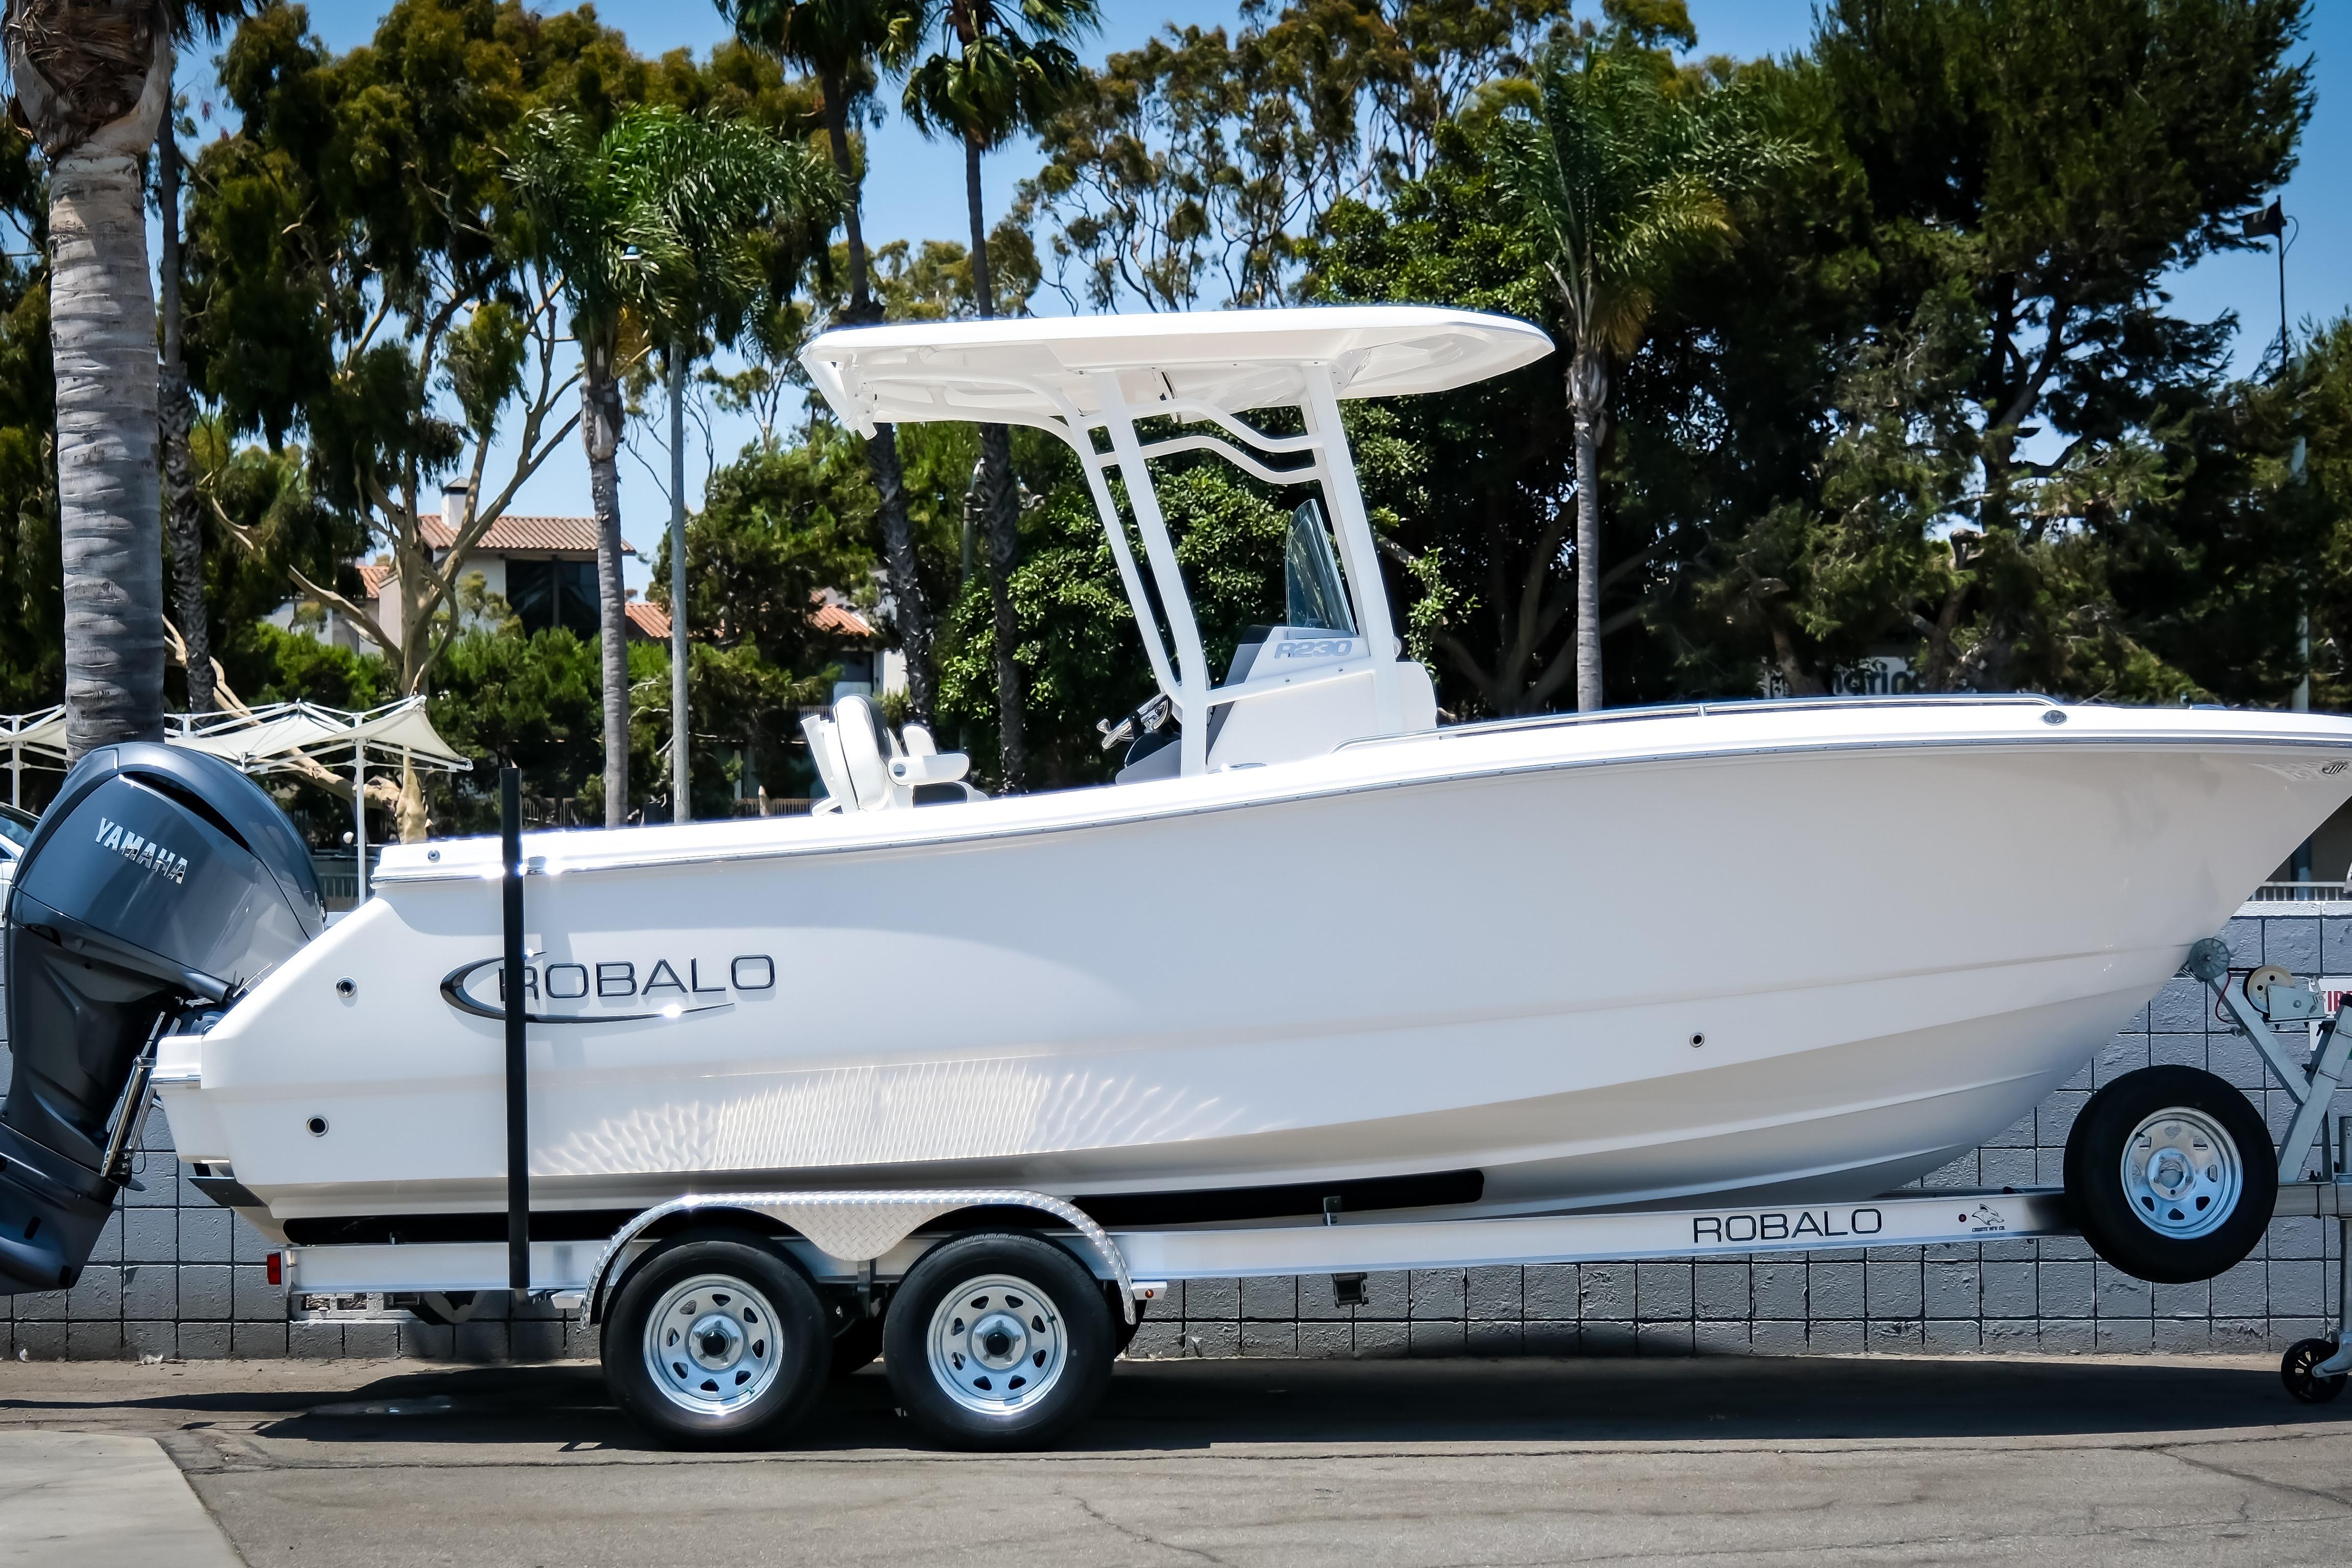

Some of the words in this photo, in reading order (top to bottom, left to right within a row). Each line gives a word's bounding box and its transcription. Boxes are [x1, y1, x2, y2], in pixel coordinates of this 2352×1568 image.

[1274, 640, 1353, 659] R230
[95, 817, 188, 884] YAMAHA
[1693, 1208, 1882, 1244] ROBALO
